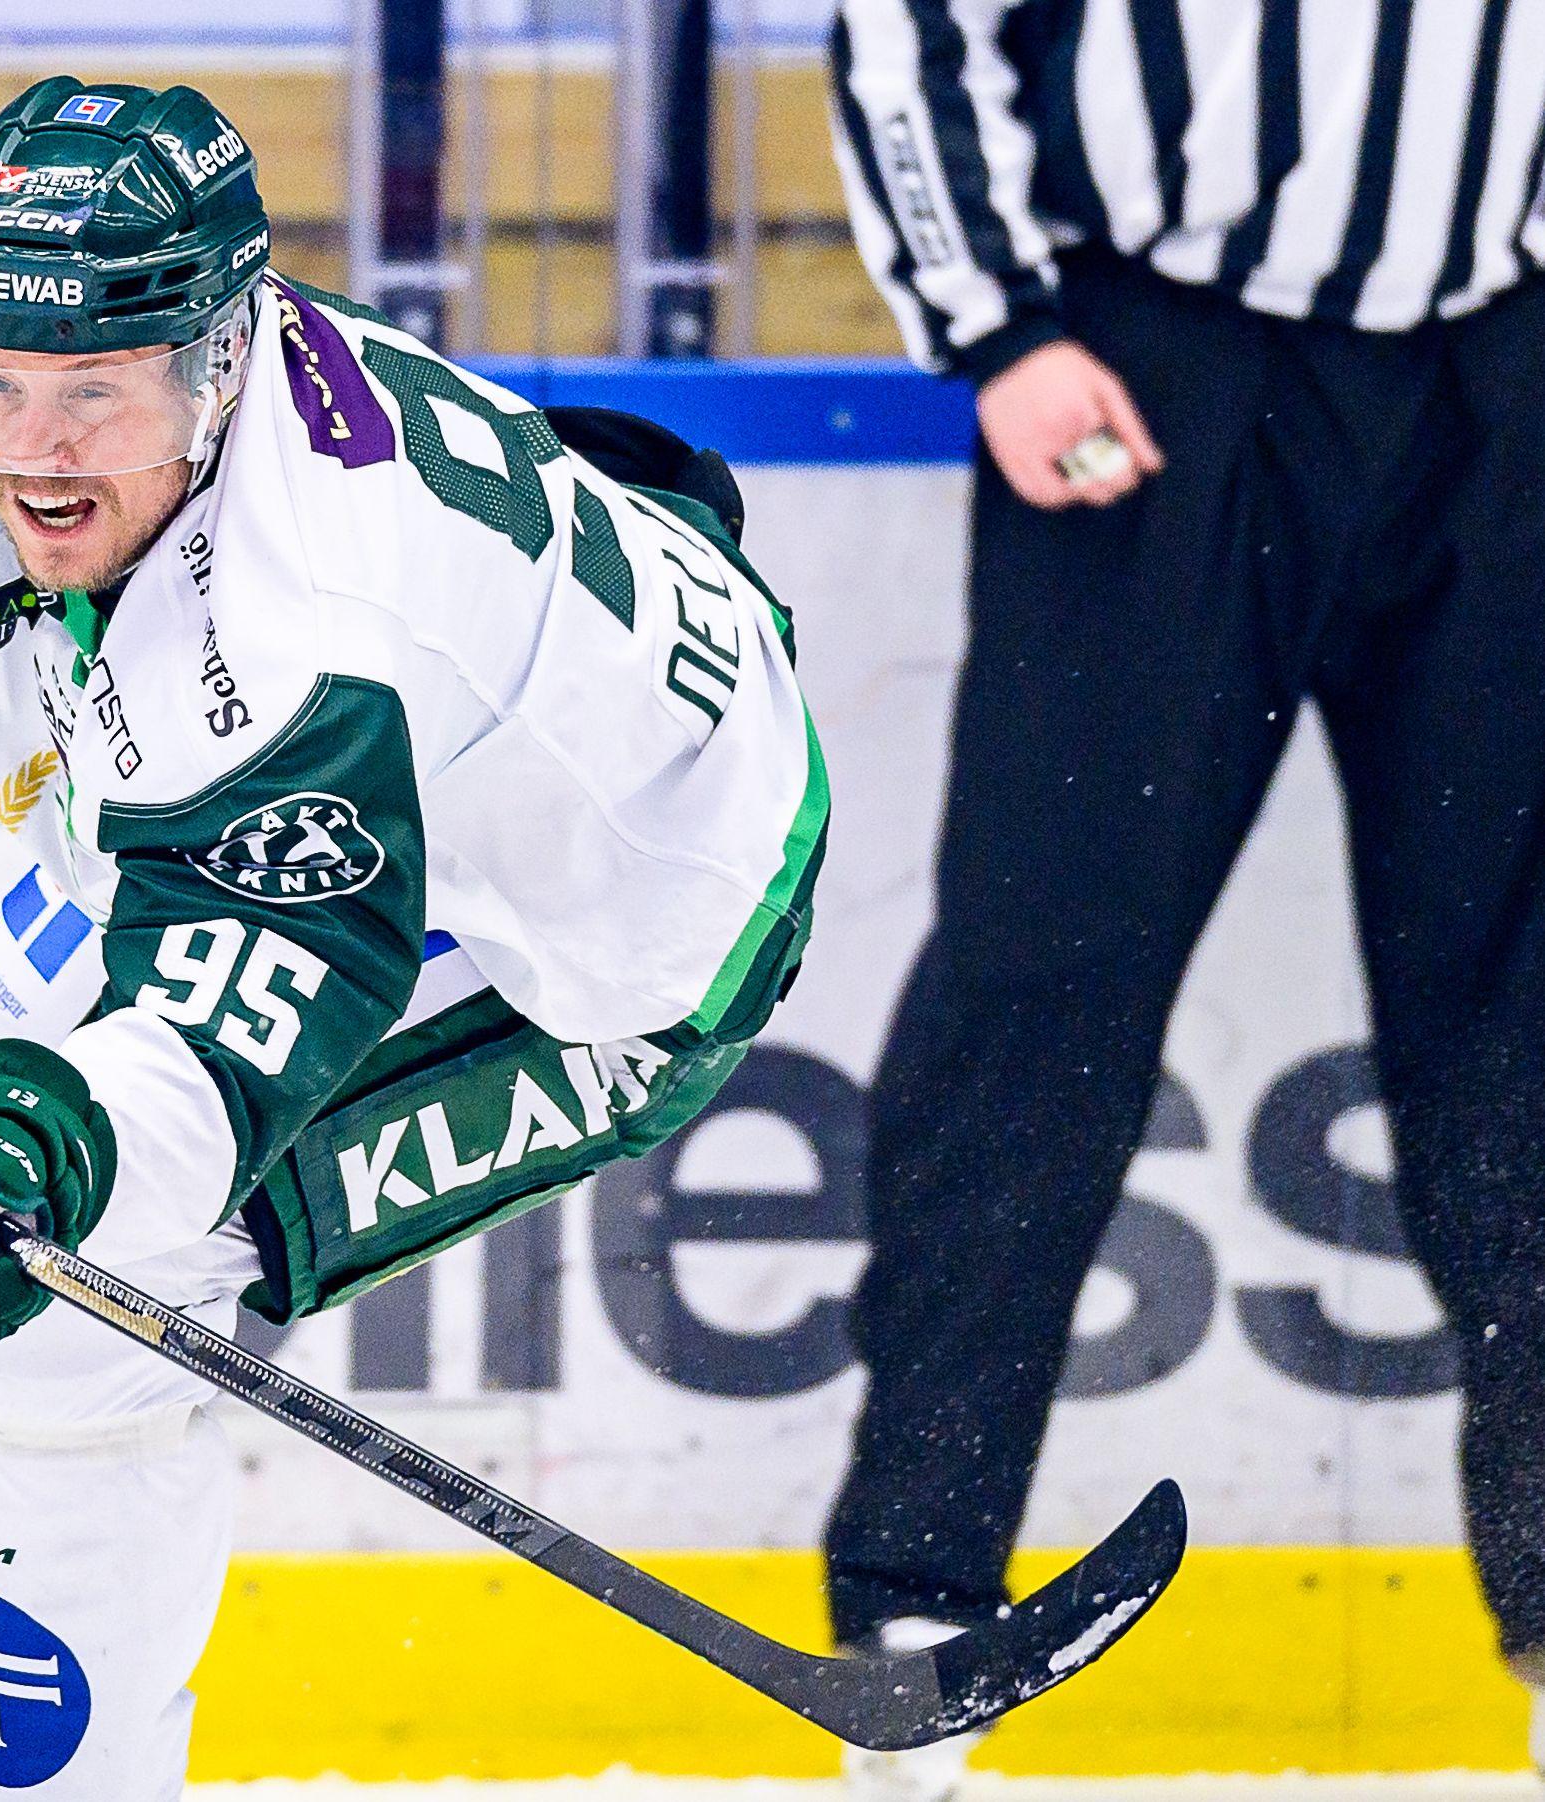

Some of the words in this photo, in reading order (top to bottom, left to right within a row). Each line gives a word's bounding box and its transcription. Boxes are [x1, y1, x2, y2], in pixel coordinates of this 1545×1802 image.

[170, 114, 245, 190] Lecab
[23, 184, 65, 198] SPEL
[28, 173, 108, 193] SVENSKA
[232, 229, 268, 270] CCM
[135, 917, 330, 1076] 95
